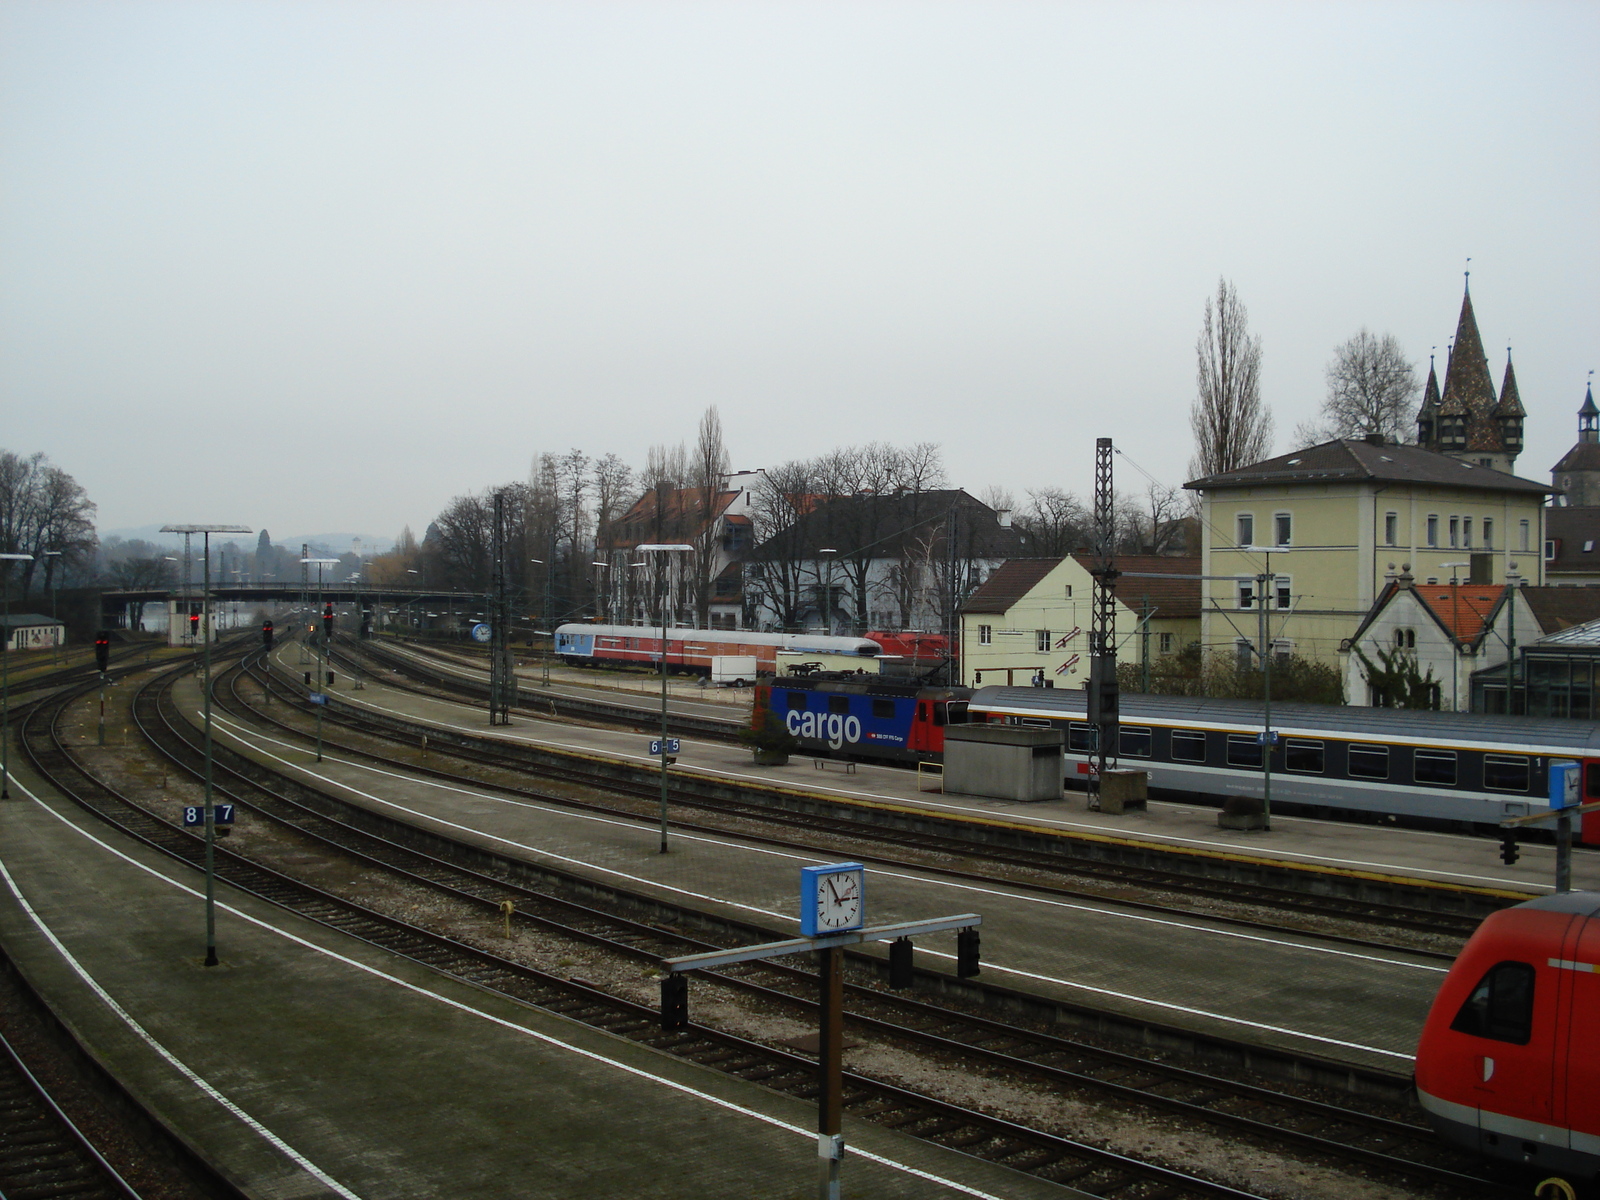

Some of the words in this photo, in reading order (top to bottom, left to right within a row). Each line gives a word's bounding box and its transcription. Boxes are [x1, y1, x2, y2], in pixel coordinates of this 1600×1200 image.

[786, 709, 861, 750] cargo
[1273, 731, 1278, 741] 3
[651, 741, 658, 753] 6
[672, 739, 679, 751] 5
[1535, 757, 1541, 767] 1
[186, 807, 197, 823] 8
[222, 804, 233, 820] 7
